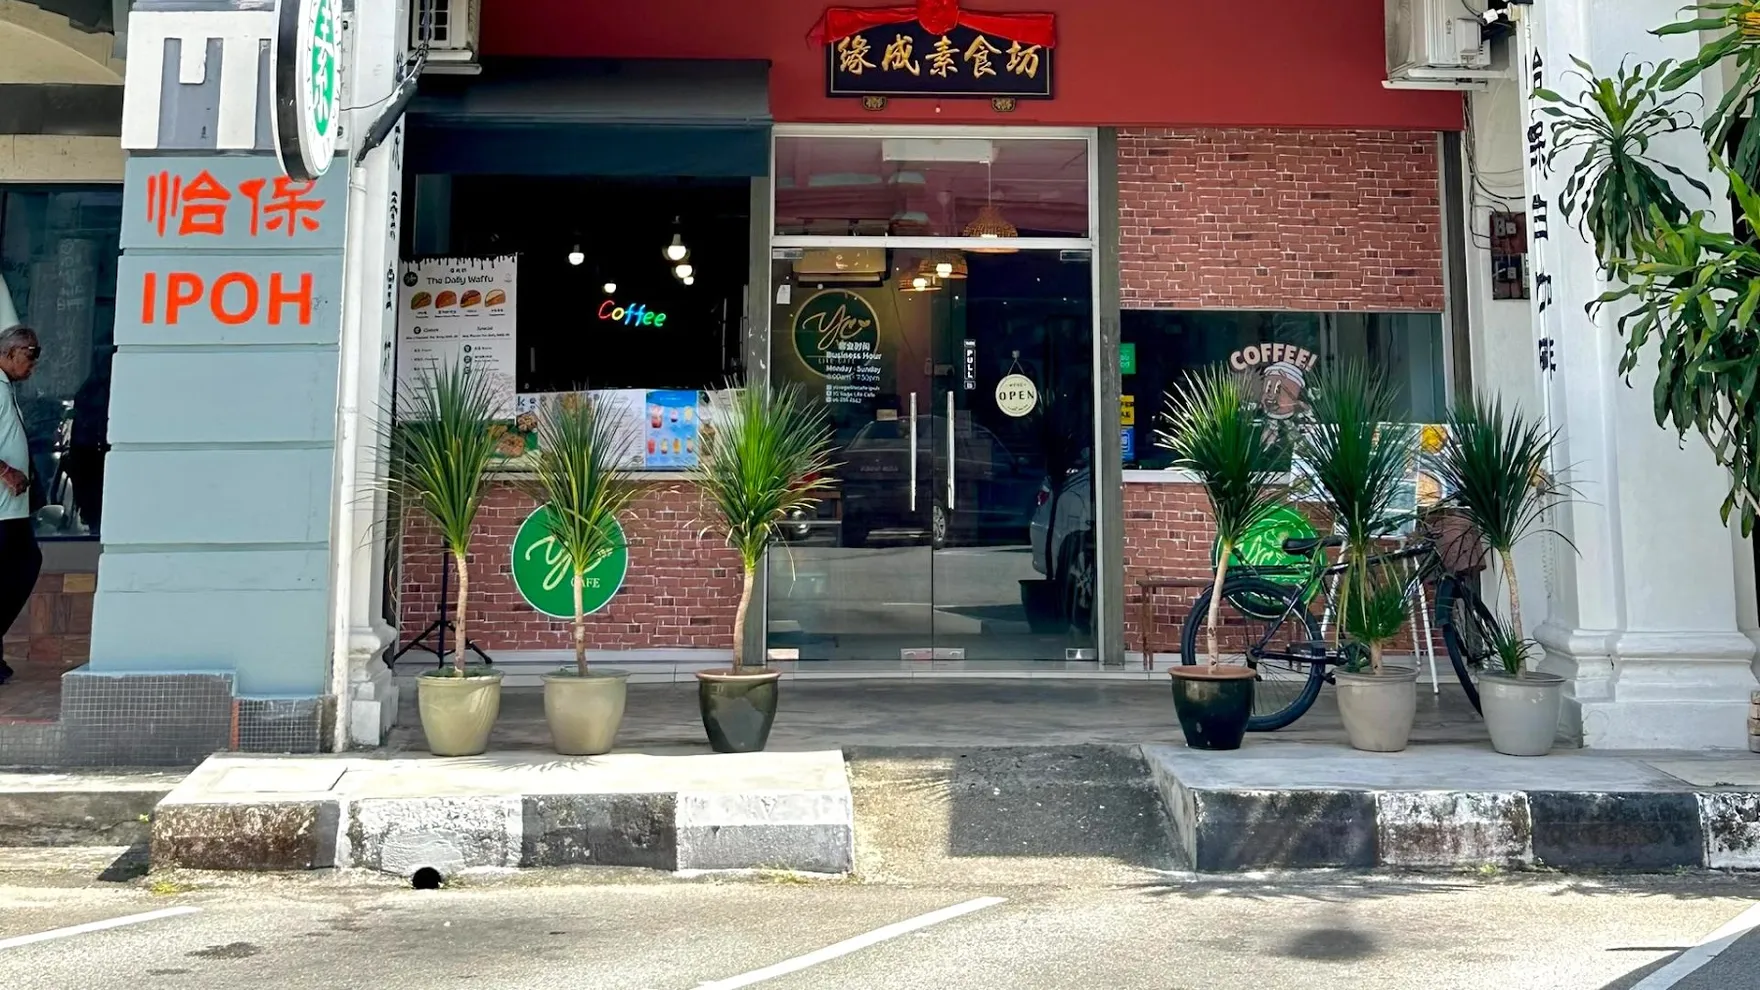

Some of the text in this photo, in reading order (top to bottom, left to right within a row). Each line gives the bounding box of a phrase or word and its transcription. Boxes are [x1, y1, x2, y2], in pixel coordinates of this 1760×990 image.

[427, 277, 443, 285] The
[444, 276, 466, 286] Daily
[142, 271, 314, 326] IPOH
[598, 300, 667, 328] Coffee
[826, 351, 882, 360] Business Hour
[966, 349, 974, 379] PULL
[1230, 343, 1318, 372] COFFEE!
[826, 365, 882, 374] Monday Sunday
[999, 390, 1034, 401] OPEN
